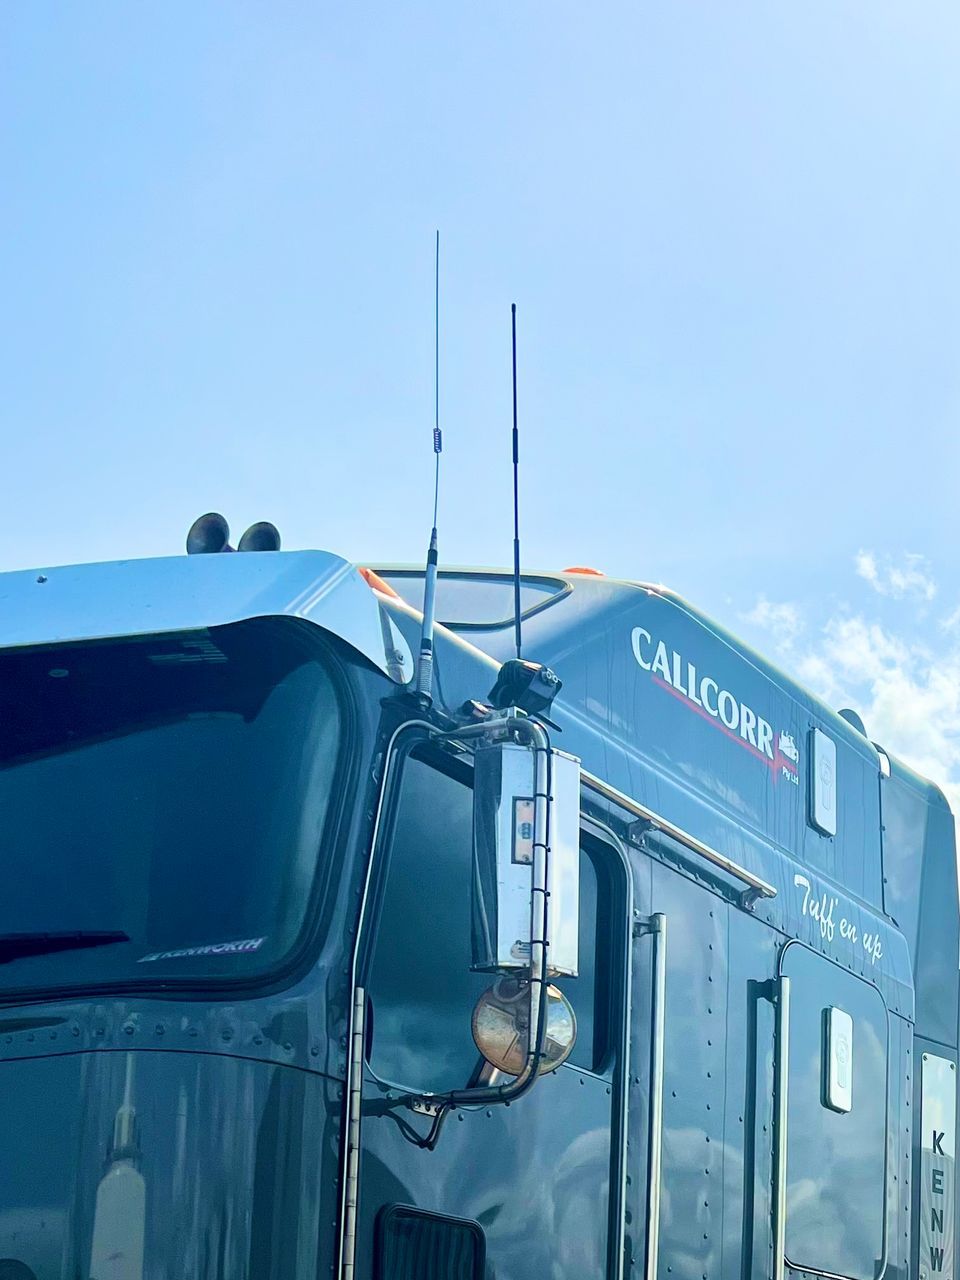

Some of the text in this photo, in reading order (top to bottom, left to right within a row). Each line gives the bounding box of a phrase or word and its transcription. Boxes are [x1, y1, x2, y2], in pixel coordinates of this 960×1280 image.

[631, 626, 774, 760] CALLCORR
[782, 766, 799, 785] Pty Ltd
[863, 933, 883, 965] up
